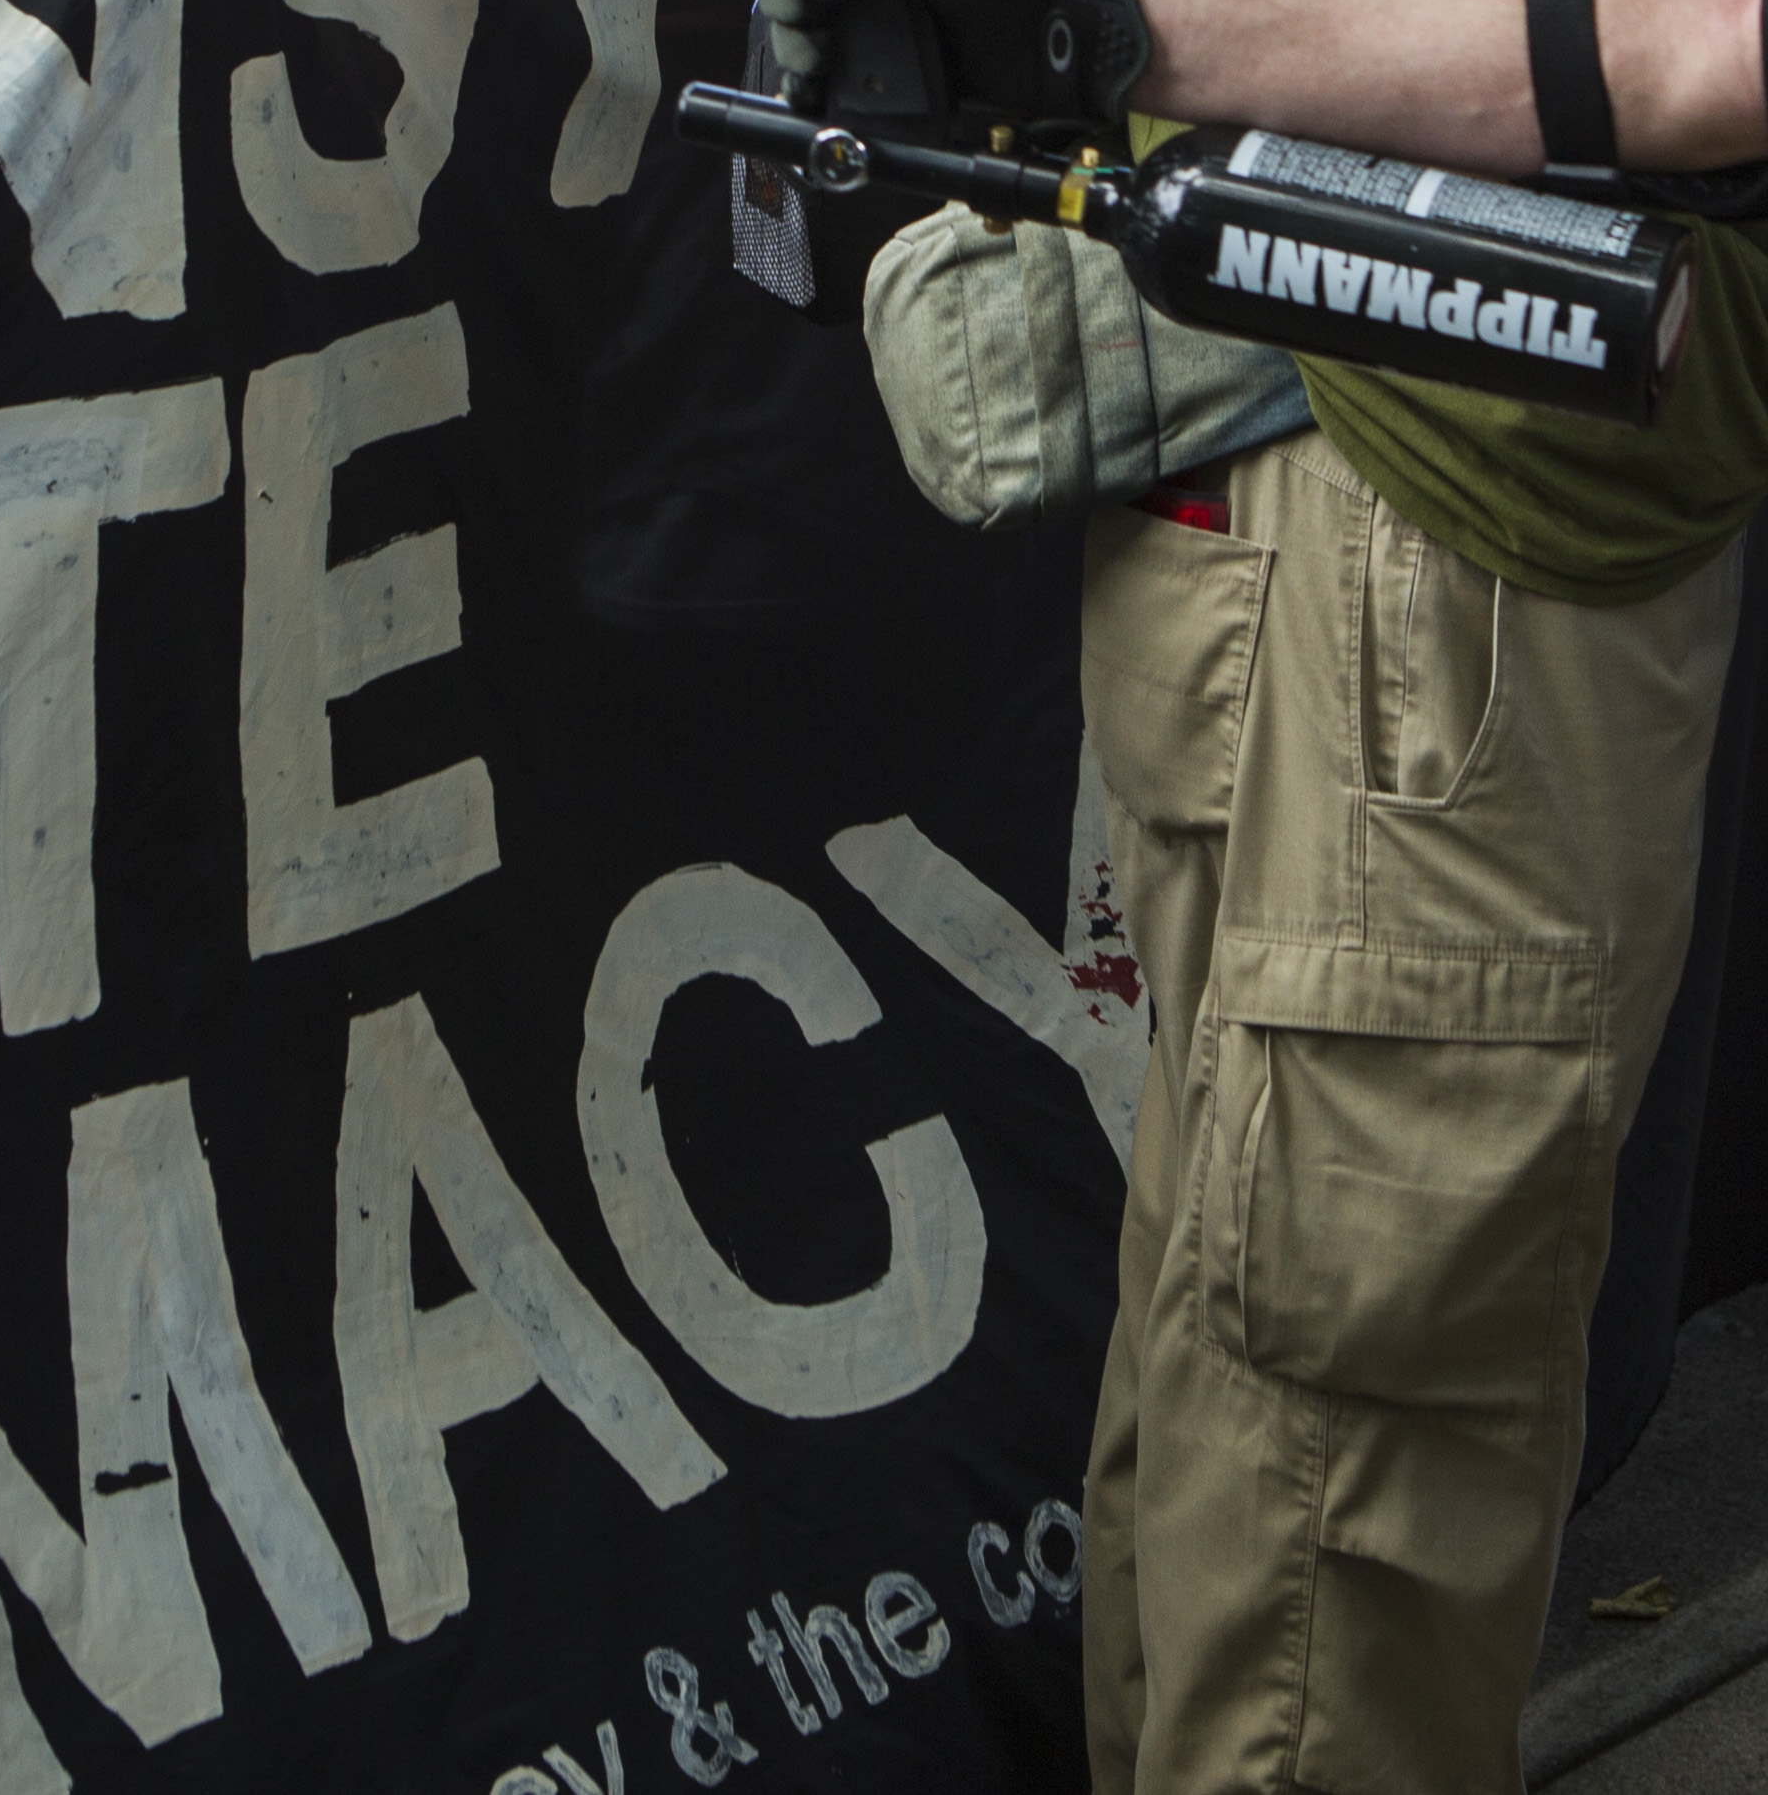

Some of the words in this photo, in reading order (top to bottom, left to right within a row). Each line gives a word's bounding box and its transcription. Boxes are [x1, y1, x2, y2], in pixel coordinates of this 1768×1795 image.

[1215, 223, 1609, 371] TIPPMANN
[644, 1647, 759, 1787] &
[747, 1591, 951, 1735] the
